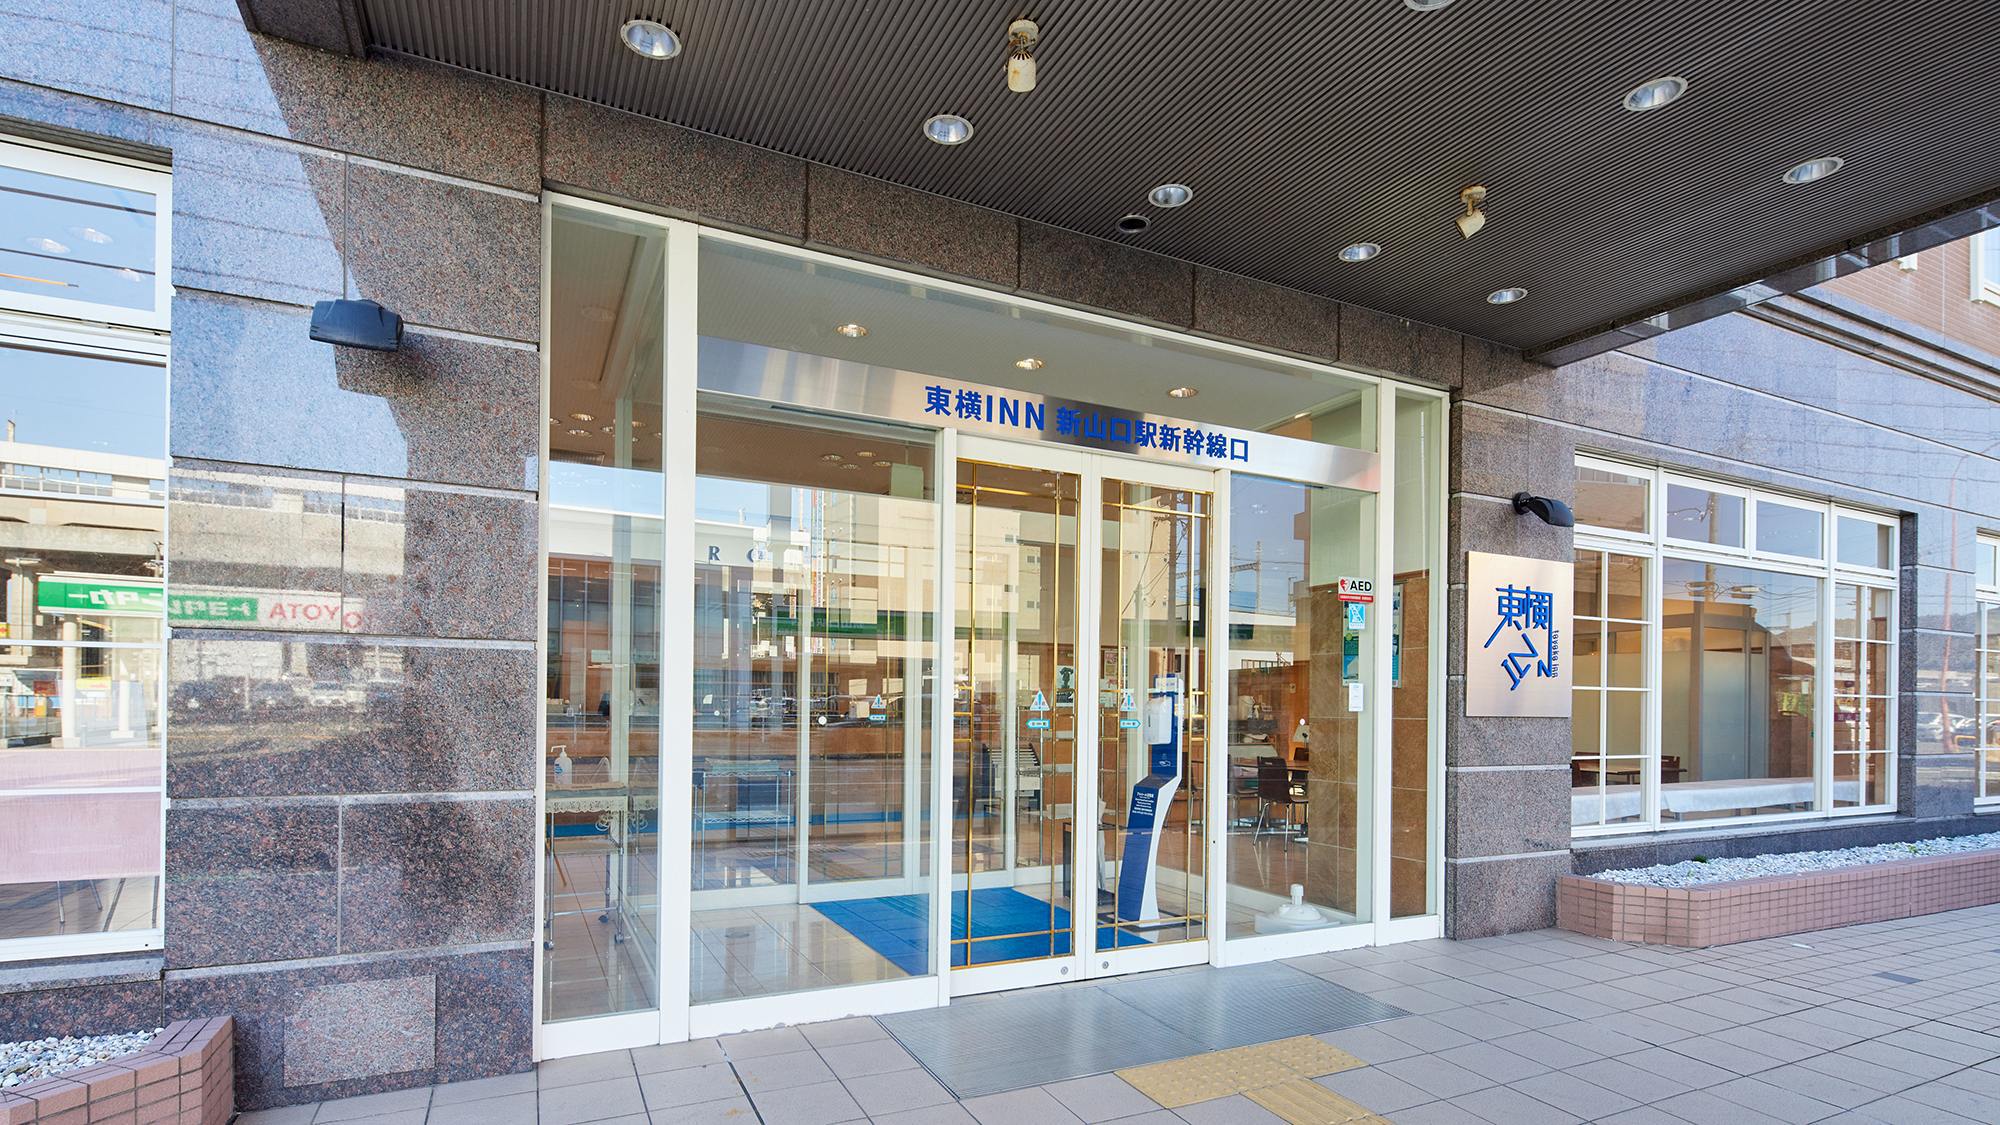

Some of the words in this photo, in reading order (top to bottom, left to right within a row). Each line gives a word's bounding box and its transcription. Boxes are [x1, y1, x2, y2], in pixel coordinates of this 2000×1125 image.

[925, 385, 1045, 430] 東横INN
[1056, 407, 1249, 462] 新山口駅新幹線口
[1350, 580, 1372, 591] AED
